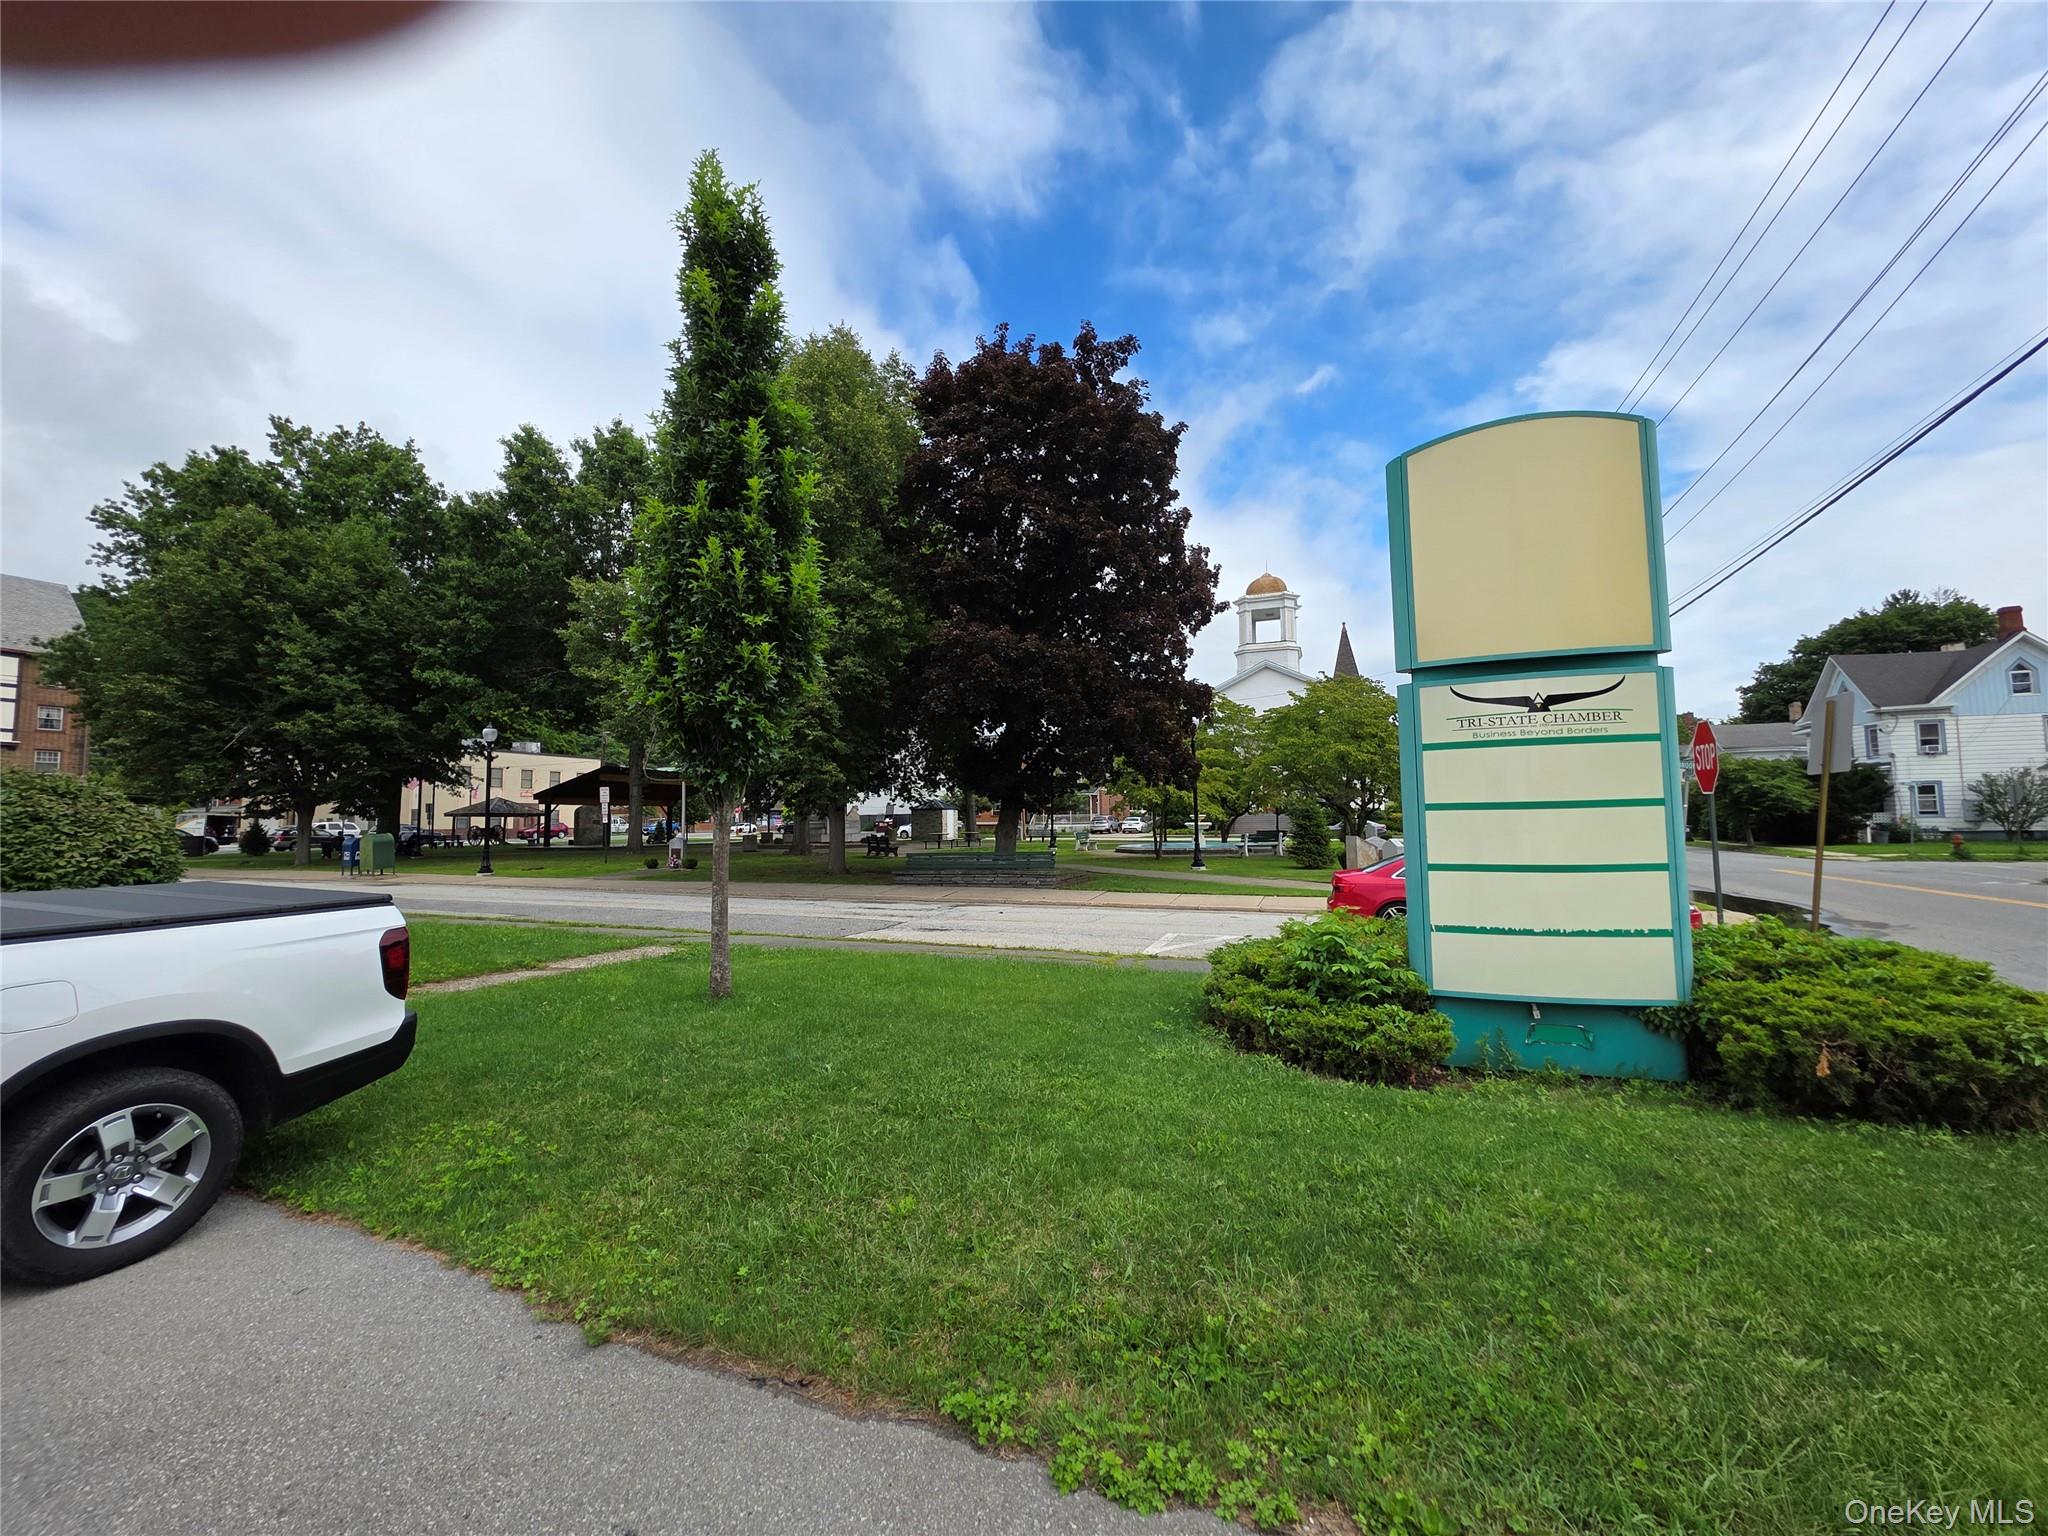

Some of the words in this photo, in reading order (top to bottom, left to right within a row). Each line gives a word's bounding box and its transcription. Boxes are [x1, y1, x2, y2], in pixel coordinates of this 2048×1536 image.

[1456, 714, 1539, 729] TRI-STATE
[1542, 711, 1623, 724] CHAMBER
[1472, 730, 1517, 739] Business
[1519, 728, 1564, 737] Beyond
[1566, 726, 1609, 735] Borders
[1696, 743, 1716, 770] STOP
